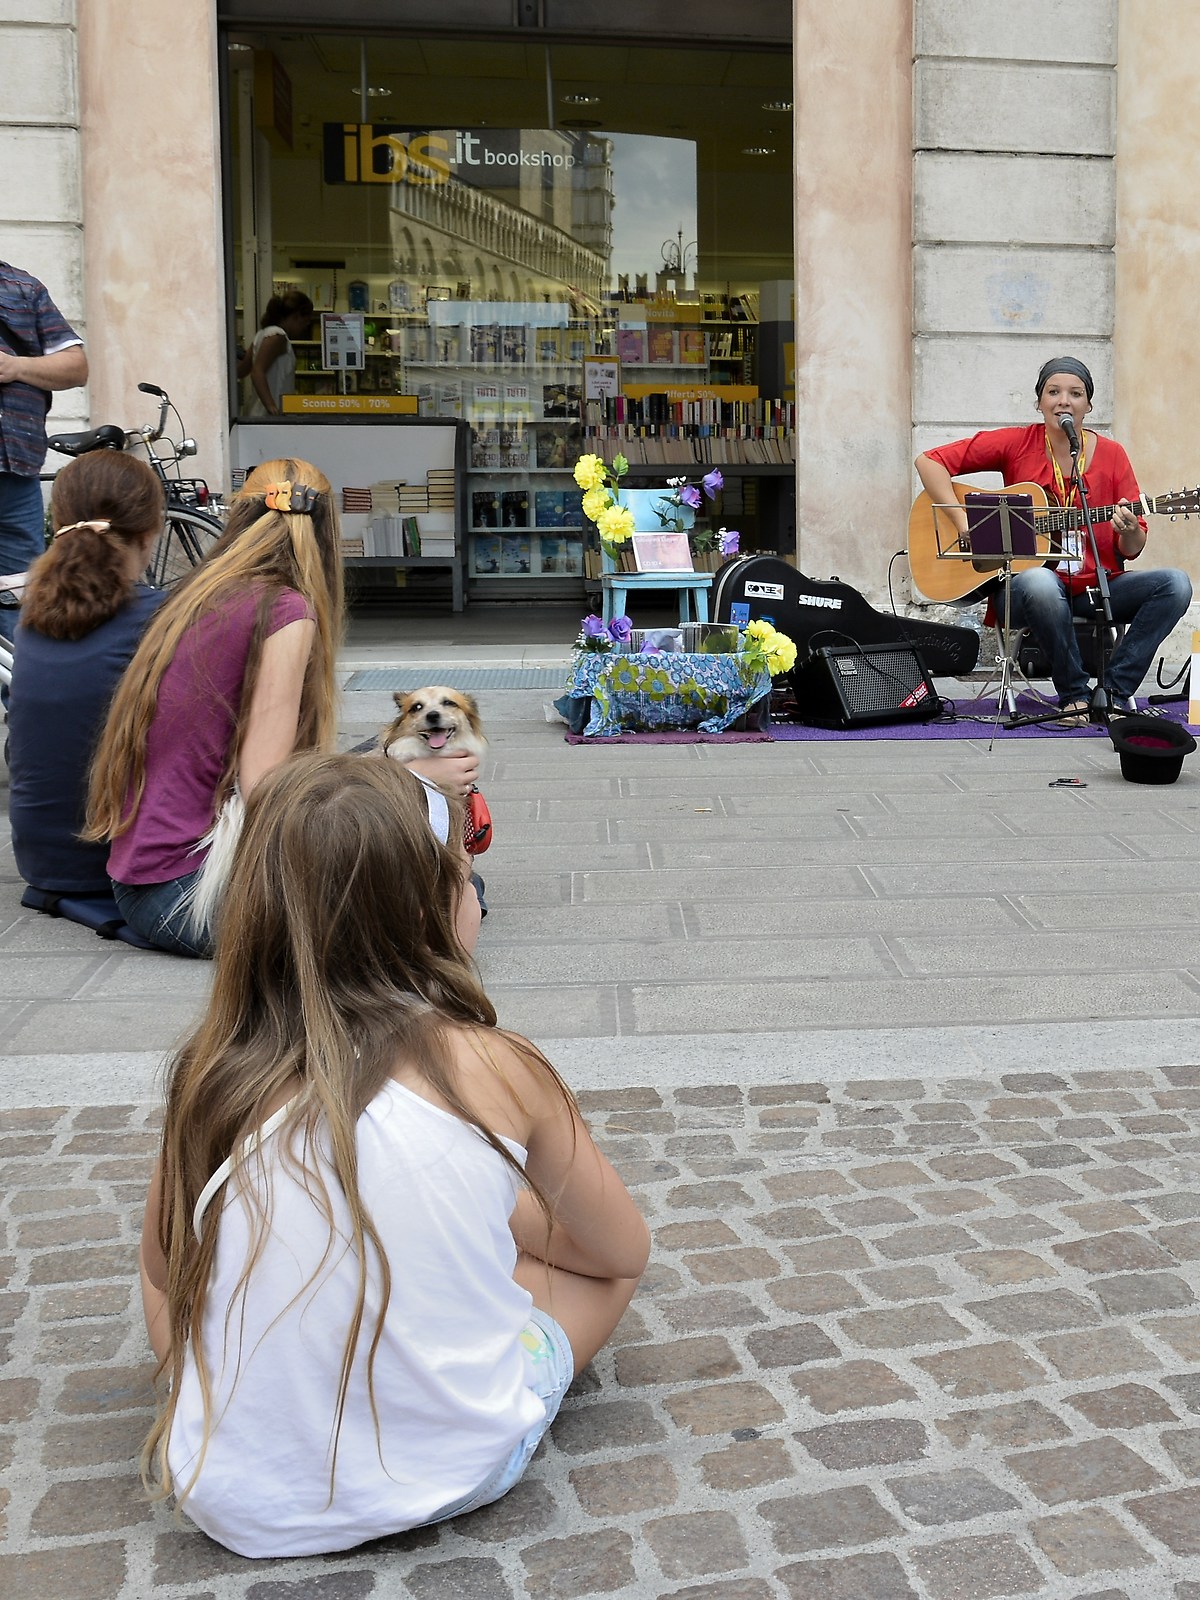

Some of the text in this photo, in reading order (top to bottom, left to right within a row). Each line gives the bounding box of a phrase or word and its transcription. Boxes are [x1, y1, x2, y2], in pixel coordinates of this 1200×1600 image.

[485, 149, 575, 171] bookshop
[697, 390, 716, 399] 50%
[302, 398, 391, 409] Sconto 50% 70%
[798, 594, 842, 610] SHURE
